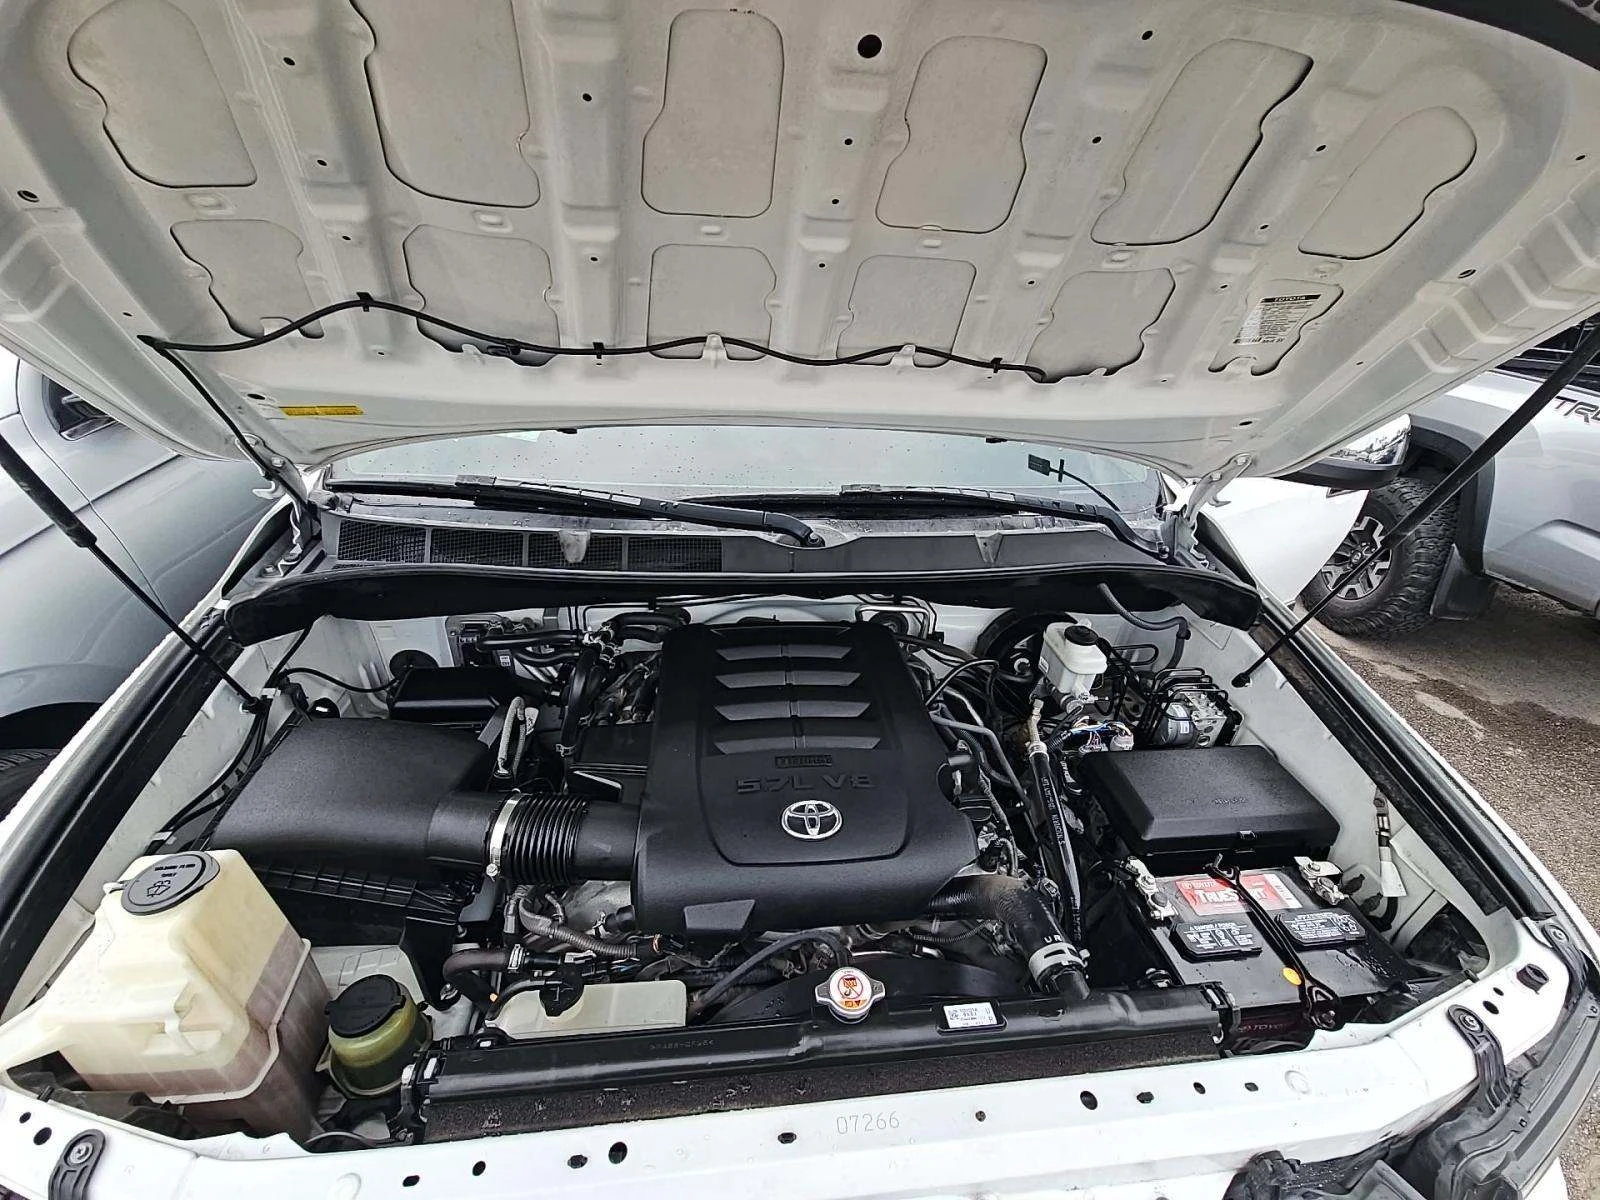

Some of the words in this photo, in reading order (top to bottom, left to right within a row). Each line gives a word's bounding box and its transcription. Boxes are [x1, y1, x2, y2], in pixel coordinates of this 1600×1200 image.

[1554, 395, 1600, 423] TR
[822, 773, 878, 790] V8
[836, 1111, 900, 1135] 07266
